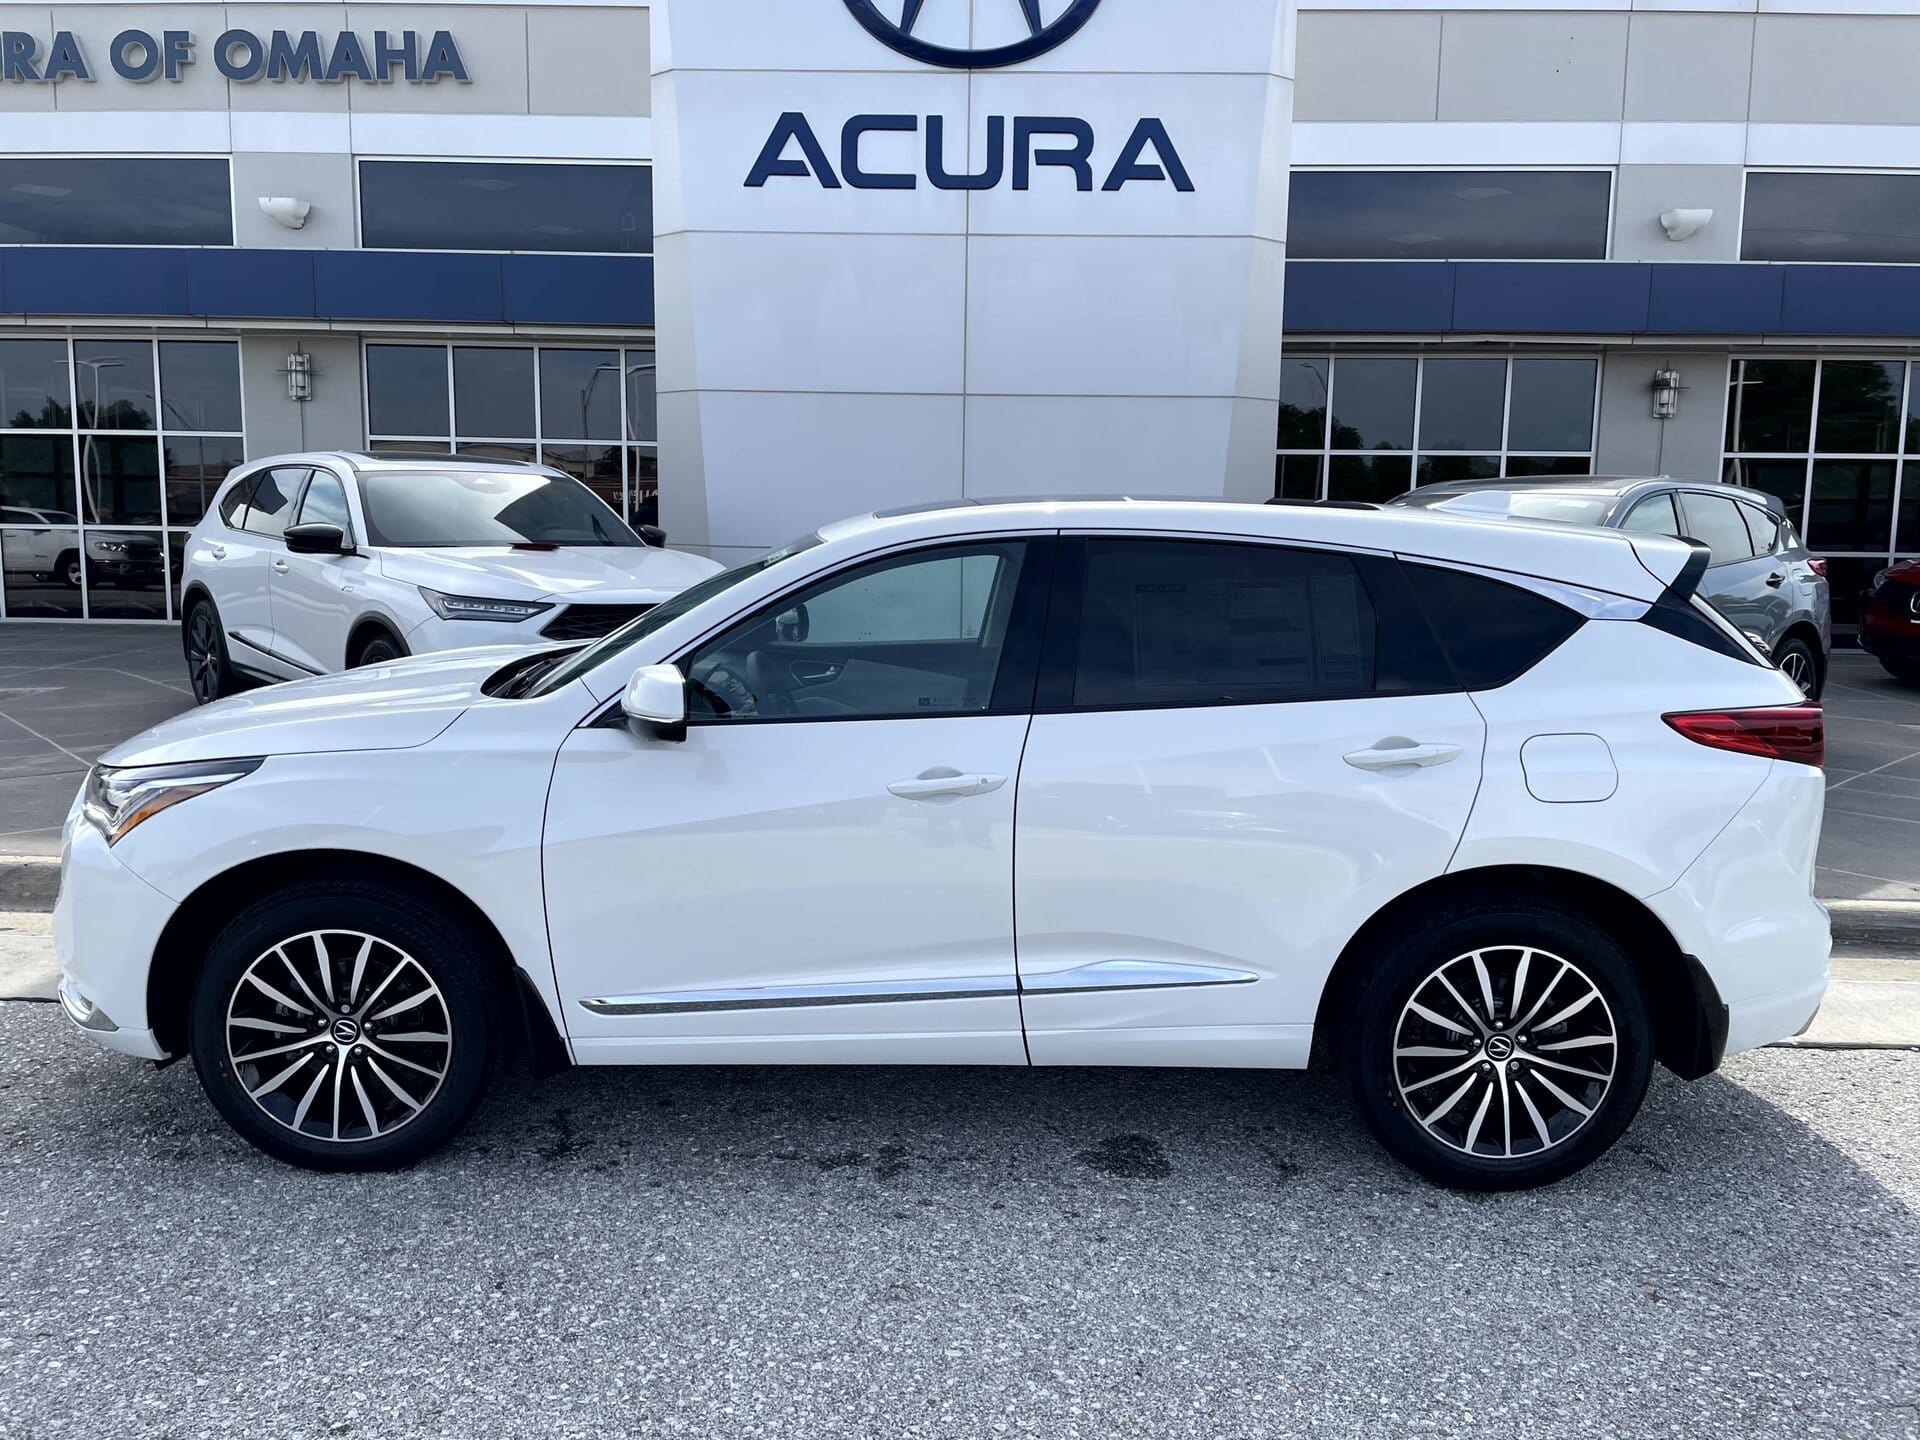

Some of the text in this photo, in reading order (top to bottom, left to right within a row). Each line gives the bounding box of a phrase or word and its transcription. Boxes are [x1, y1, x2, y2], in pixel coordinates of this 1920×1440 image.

[0, 29, 471, 83] RA OF OMAHA
[743, 112, 1195, 191] ACURA
